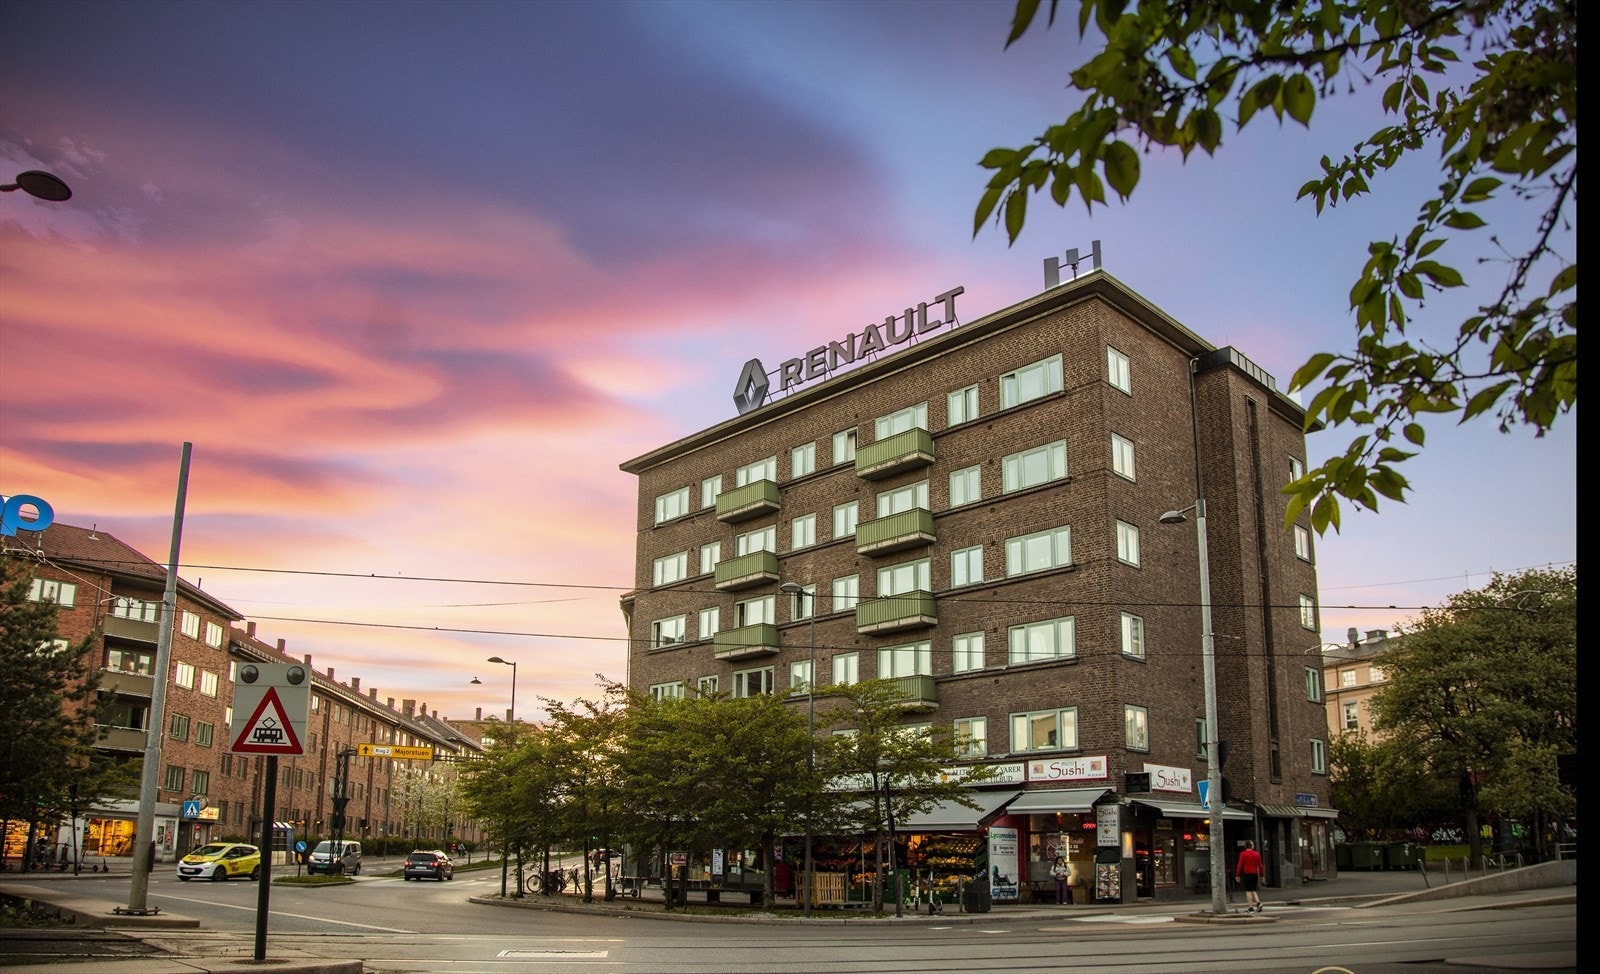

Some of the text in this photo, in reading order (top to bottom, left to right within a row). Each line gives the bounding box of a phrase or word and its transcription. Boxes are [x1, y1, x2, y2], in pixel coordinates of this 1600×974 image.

[780, 286, 964, 390] RENAULT
[395, 748, 430, 756] Majorstuen
[1000, 765, 1021, 774] VARER
[1048, 761, 1085, 779] Sushi
[1156, 769, 1181, 788] Sushi
[991, 832, 1017, 840] Lycamobile
